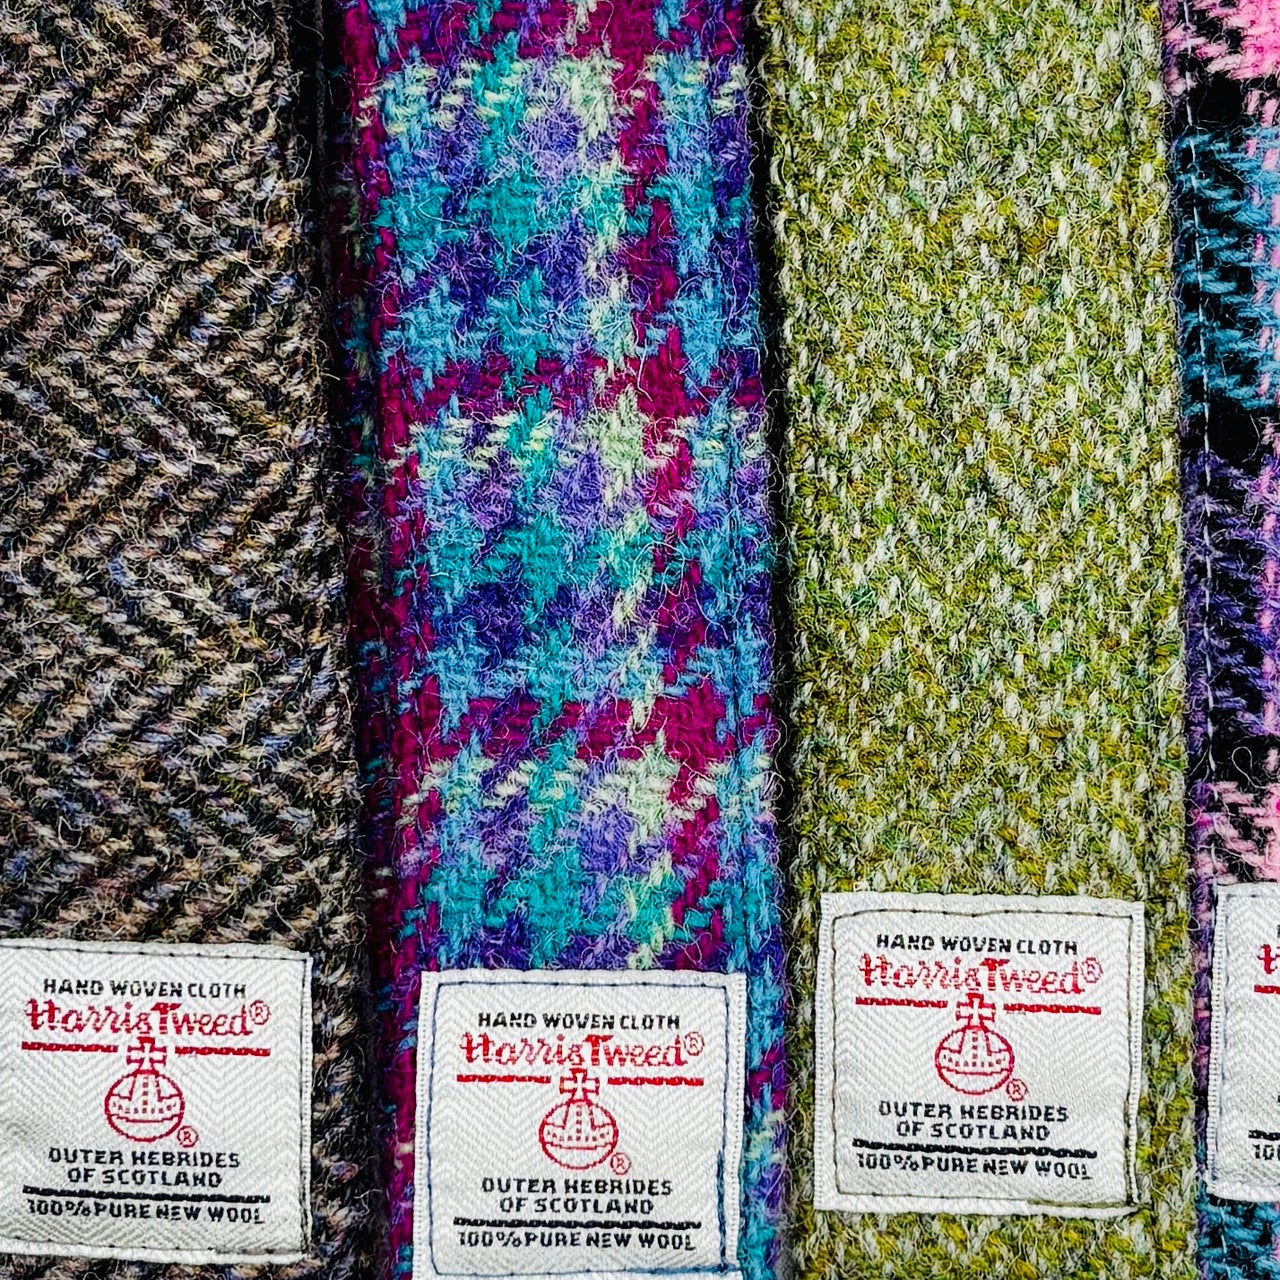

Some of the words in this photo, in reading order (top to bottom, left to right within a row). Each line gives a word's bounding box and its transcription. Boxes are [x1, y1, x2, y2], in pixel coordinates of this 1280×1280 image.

[877, 934, 934, 950] HAND
[941, 936, 1011, 953] WOVEN
[1017, 940, 1078, 955] CLOTH
[858, 953, 981, 990] Harris
[44, 978, 103, 995] HAND
[109, 980, 183, 997] WOVEN
[188, 982, 246, 999] CLOTH
[25, 998, 152, 1034] Harris
[478, 1012, 537, 1028] HAND
[543, 1014, 614, 1029] WOVEN
[620, 1015, 679, 1030] CLOTH
[460, 1032, 585, 1066] Harris
[879, 1101, 952, 1119] OUTER
[960, 1104, 1068, 1121] HEBRIDES
[897, 1122, 920, 1137] OF
[931, 1123, 1050, 1141] SCOTLAND
[49, 1147, 123, 1166] OUTER
[132, 1151, 240, 1168] HEBRIDES
[858, 1154, 919, 1171] 100%
[923, 1155, 977, 1173] PURE
[984, 1159, 1028, 1175] NEW
[1035, 1161, 1091, 1180] WOOL
[68, 1169, 90, 1183] OF
[104, 1170, 222, 1188] SCOTLAND
[482, 1178, 556, 1194] OUTER
[565, 1180, 671, 1196] HEBRIDES
[28, 1199, 91, 1217] 100%
[95, 1201, 149, 1219] PURE
[157, 1204, 200, 1220] NEW
[208, 1206, 264, 1223] WOOL
[500, 1198, 527, 1213] OF
[535, 1199, 654, 1214] SCOTLAND
[458, 1231, 521, 1248] 100%
[525, 1232, 580, 1248] PURE
[587, 1233, 631, 1248] NEW
[639, 1233, 696, 1250] WOOL
